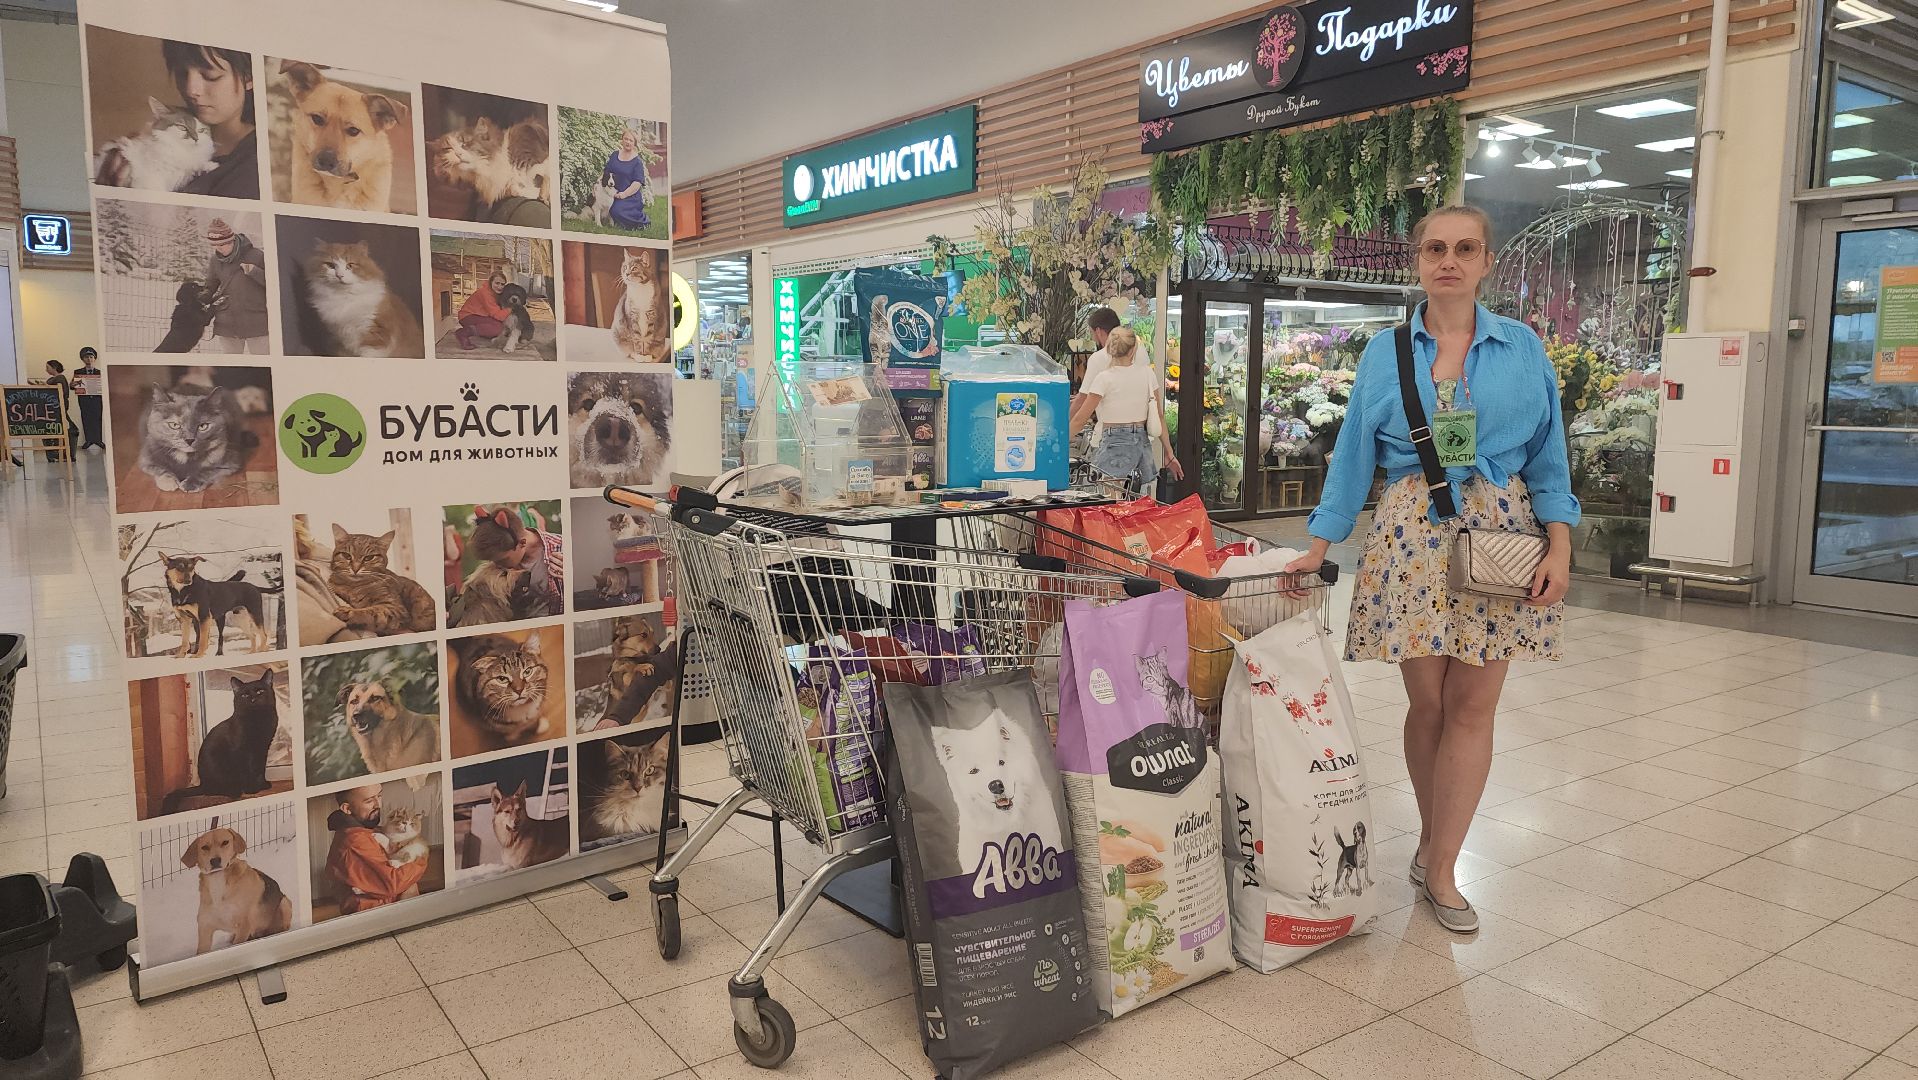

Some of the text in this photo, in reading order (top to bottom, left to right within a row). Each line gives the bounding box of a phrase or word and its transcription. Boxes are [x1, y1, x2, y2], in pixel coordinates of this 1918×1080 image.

[1315, 0, 1458, 62] Подарки
[1145, 56, 1250, 107] Цветы
[1247, 95, 1320, 123] Другой Букет
[821, 135, 958, 199] ХИМЧИСТКА
[894, 321, 929, 339] ONE
[10, 402, 57, 423] SALE
[379, 404, 558, 442] БУБАСТИ
[45, 422, 62, 434] 990
[382, 446, 558, 465] ДОМ ДЛЯ ЖИВОТНЫХ
[1130, 740, 1195, 777] ownat
[1162, 774, 1184, 787] Classic
[1340, 788, 1353, 798] ДЛЯ
[1174, 801, 1212, 839] natural
[1235, 792, 1260, 890] AKIMA
[954, 929, 1037, 954] ЧУВСТВИТЕЛЬНОЕ
[956, 943, 1028, 965] ПИЩЕВАРЕНИЕ
[1037, 958, 1053, 971] No
[1033, 971, 1061, 988] wheat
[962, 995, 997, 1008] ИНДЕЙКА
[925, 1005, 947, 1040] 12
[965, 1015, 981, 1027] 12
